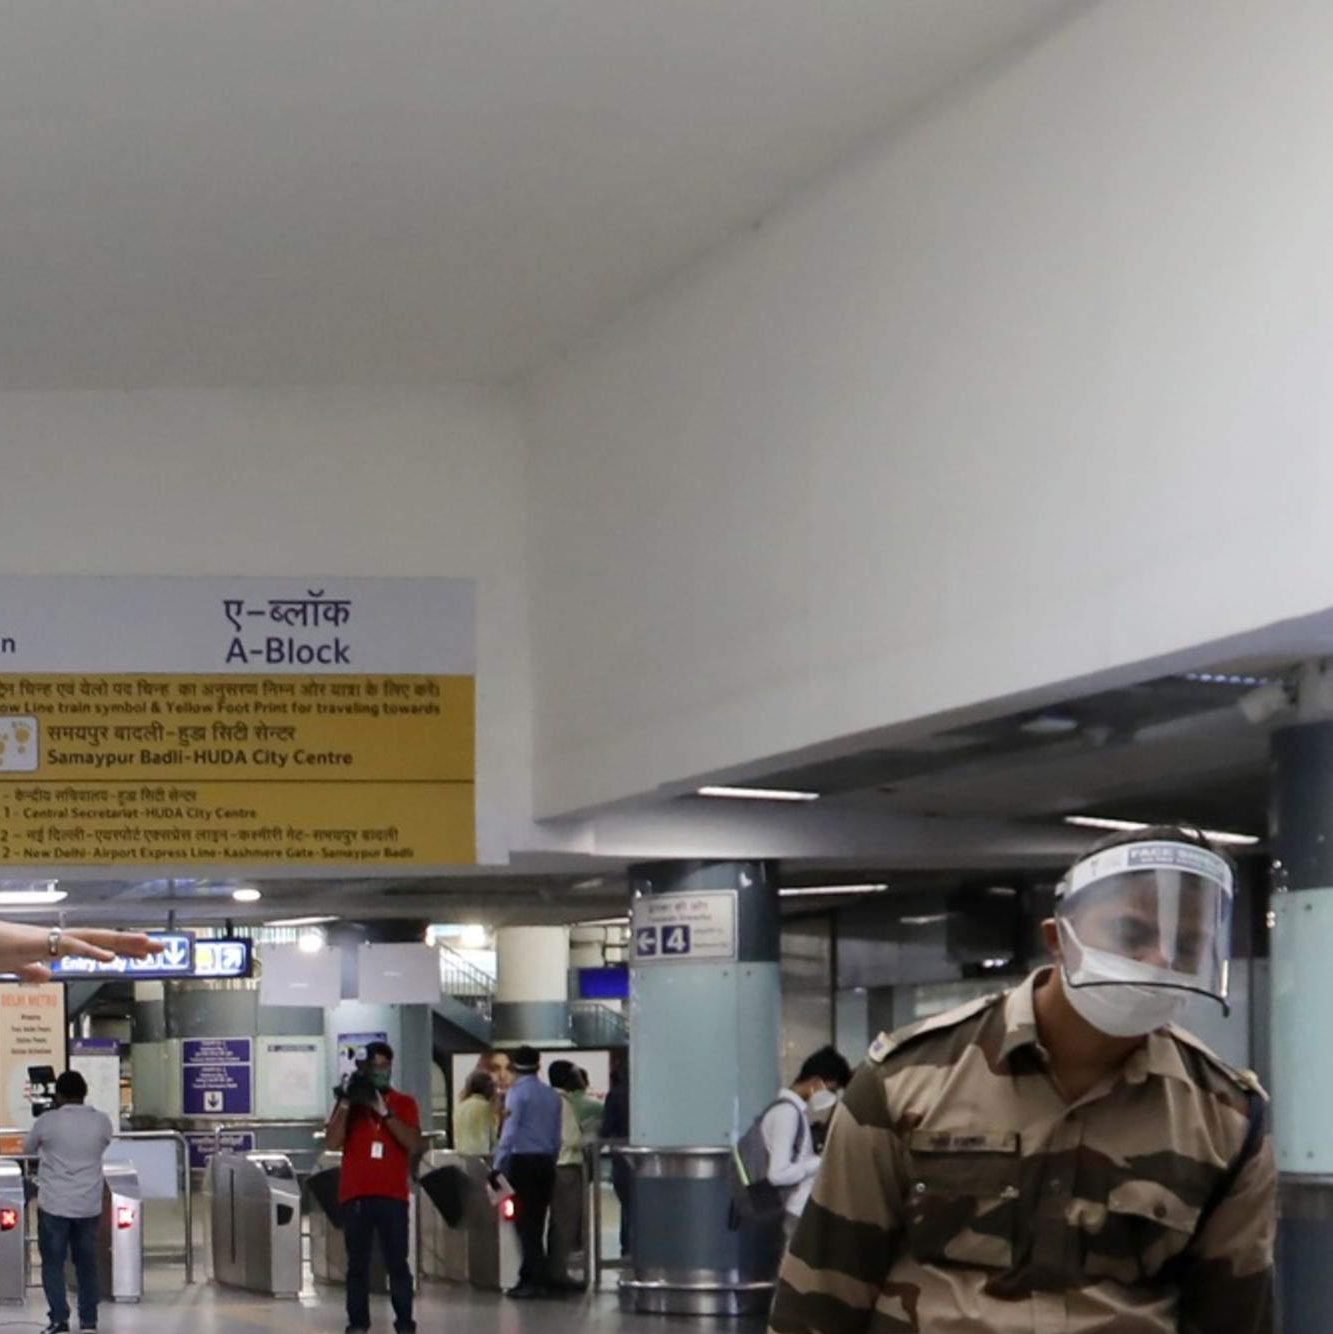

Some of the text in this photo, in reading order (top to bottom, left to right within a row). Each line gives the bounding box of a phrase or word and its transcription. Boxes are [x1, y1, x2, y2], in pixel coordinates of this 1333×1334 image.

[223, 589, 352, 632] ए-ब्लॉक
[225, 637, 350, 664] A-Block
[25, 702, 54, 714] Line
[58, 702, 90, 714] train
[94, 701, 146, 716] symbol
[151, 702, 162, 714] &
[166, 702, 212, 714] Yellow
[218, 702, 249, 714] Foot
[255, 702, 287, 714] Print
[292, 702, 312, 714] for
[317, 701, 379, 717] traveling
[383, 702, 439, 714] towards
[48, 725, 108, 746] समयपुर
[212, 722, 248, 742] सिटी
[47, 748, 353, 768] Samaypur Badli-HUDA City Centre
[4, 807, 10, 819] 1
[23, 807, 67, 819] Central
[187, 807, 211, 820] City
[215, 807, 257, 819] Centre
[23, 847, 51, 859] New
[140, 847, 187, 861] Express
[666, 927, 686, 952] 4
[62, 956, 96, 972] Entry
[1, 994, 27, 1007] DELHI
